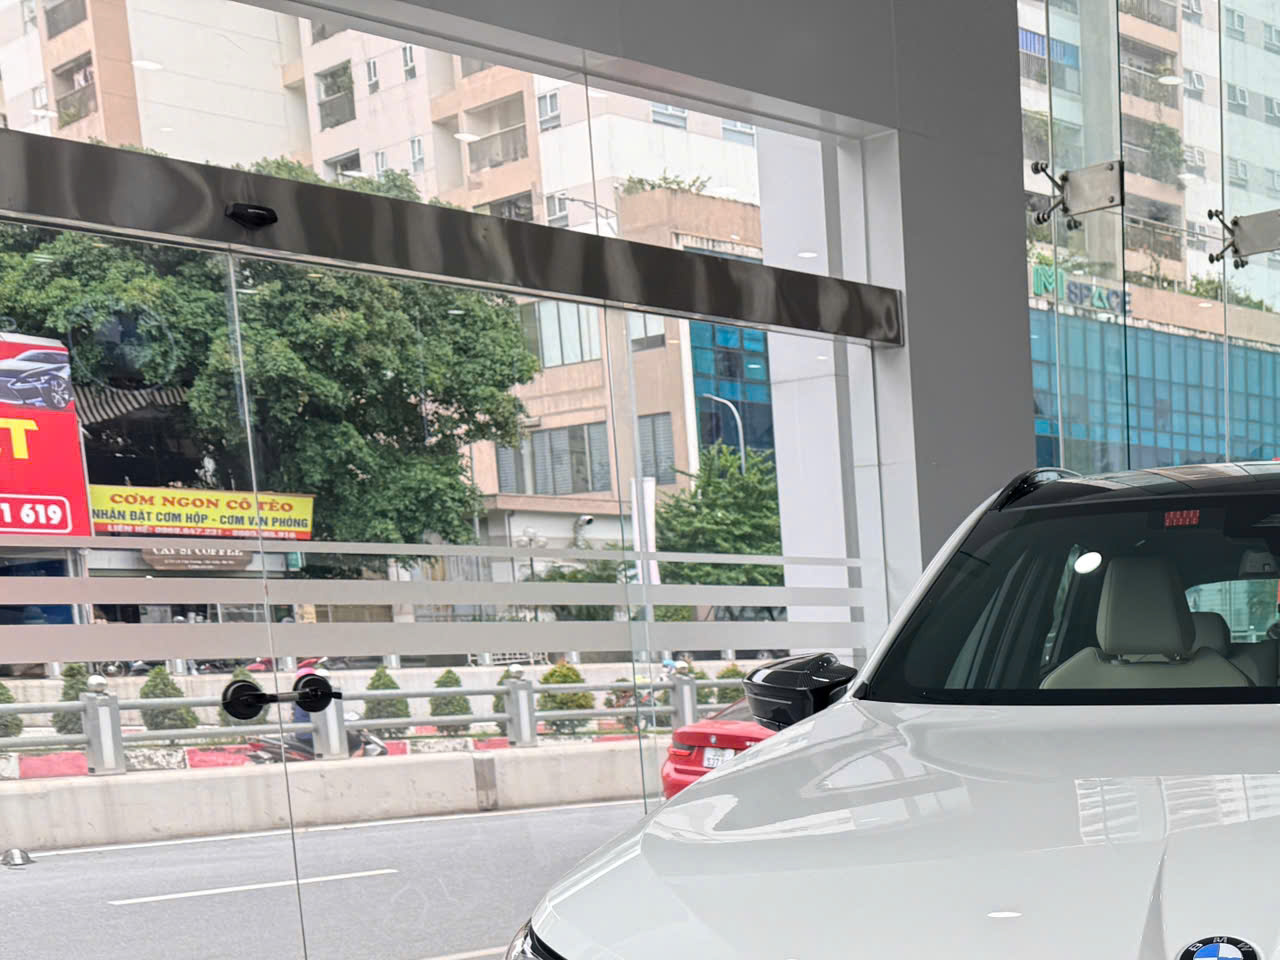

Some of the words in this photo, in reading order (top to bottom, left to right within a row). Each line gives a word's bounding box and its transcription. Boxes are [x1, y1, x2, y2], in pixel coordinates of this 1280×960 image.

[1067, 280, 1132, 314] SPACE
[110, 493, 155, 506] CƠM
[162, 496, 220, 509] NGON
[226, 497, 252, 510] CÔ
[20, 503, 63, 525] 619
[92, 507, 126, 521] NHẬN
[156, 511, 182, 522] CƠM
[185, 511, 209, 525] HỘP
[220, 514, 245, 525] CƠM
[272, 515, 308, 528] PHÒNG
[1188, 936, 1253, 951] BMW
